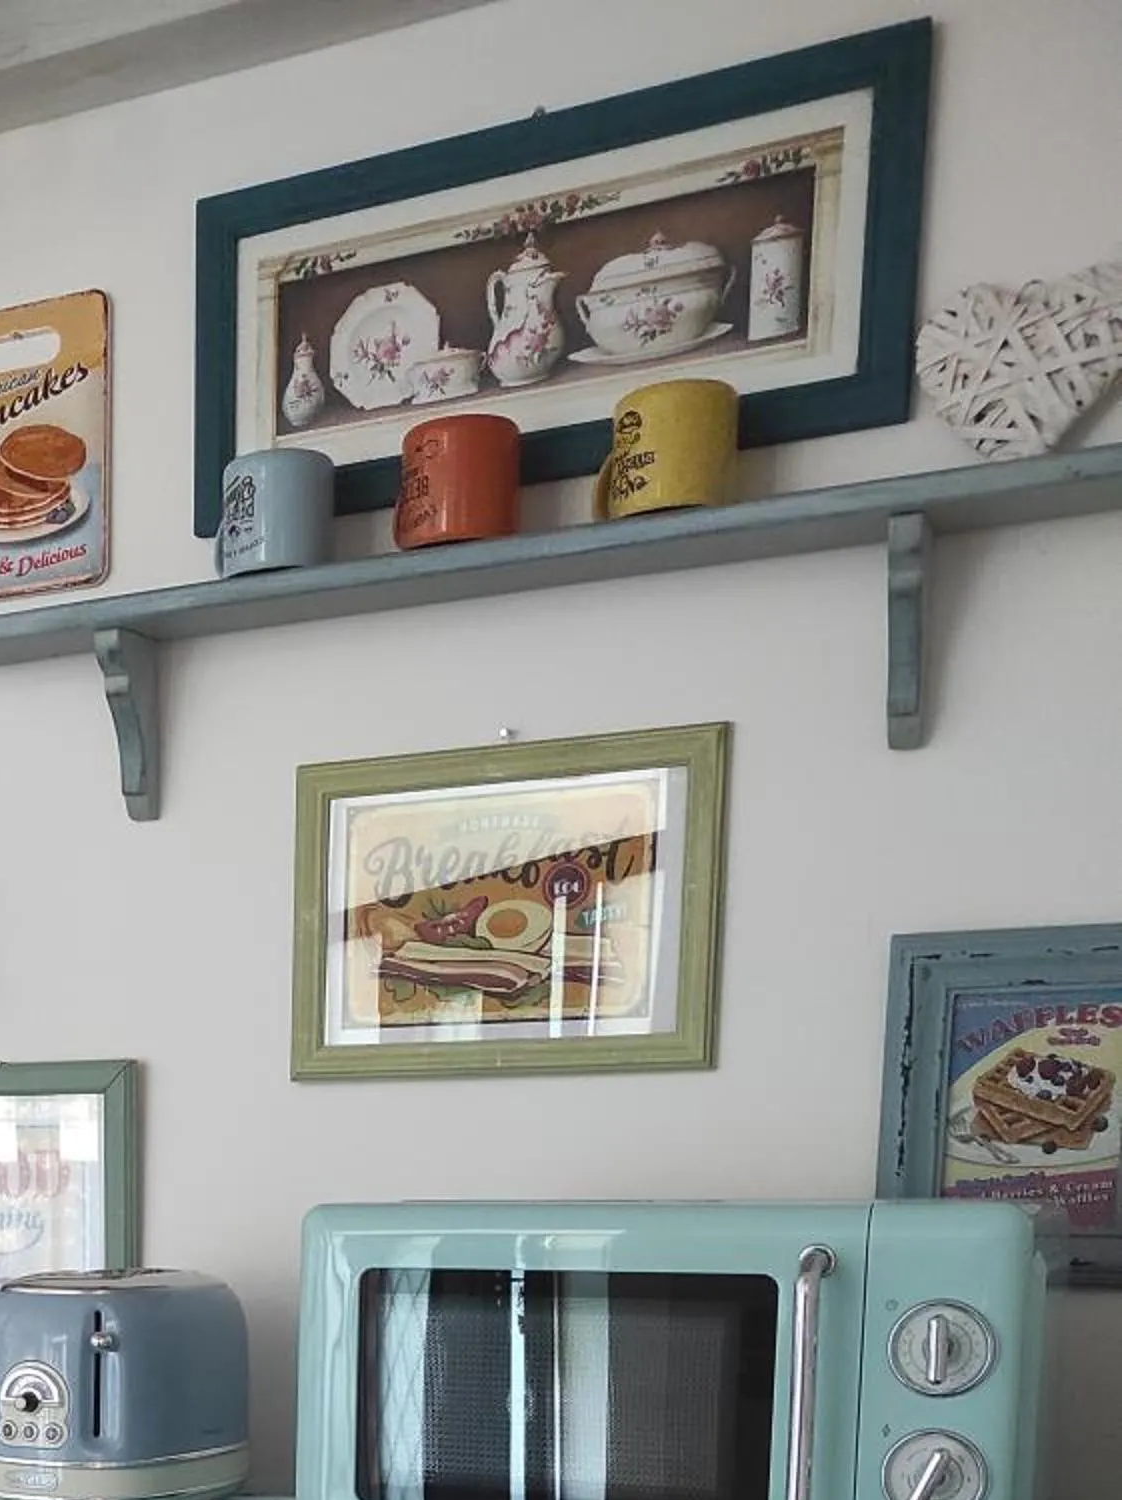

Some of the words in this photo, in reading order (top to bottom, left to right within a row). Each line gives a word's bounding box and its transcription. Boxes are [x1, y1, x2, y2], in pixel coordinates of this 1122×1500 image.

[15, 543, 88, 577] Delicious
[364, 814, 637, 908] Breakfast
[957, 1002, 1122, 1051] WAFFLES
